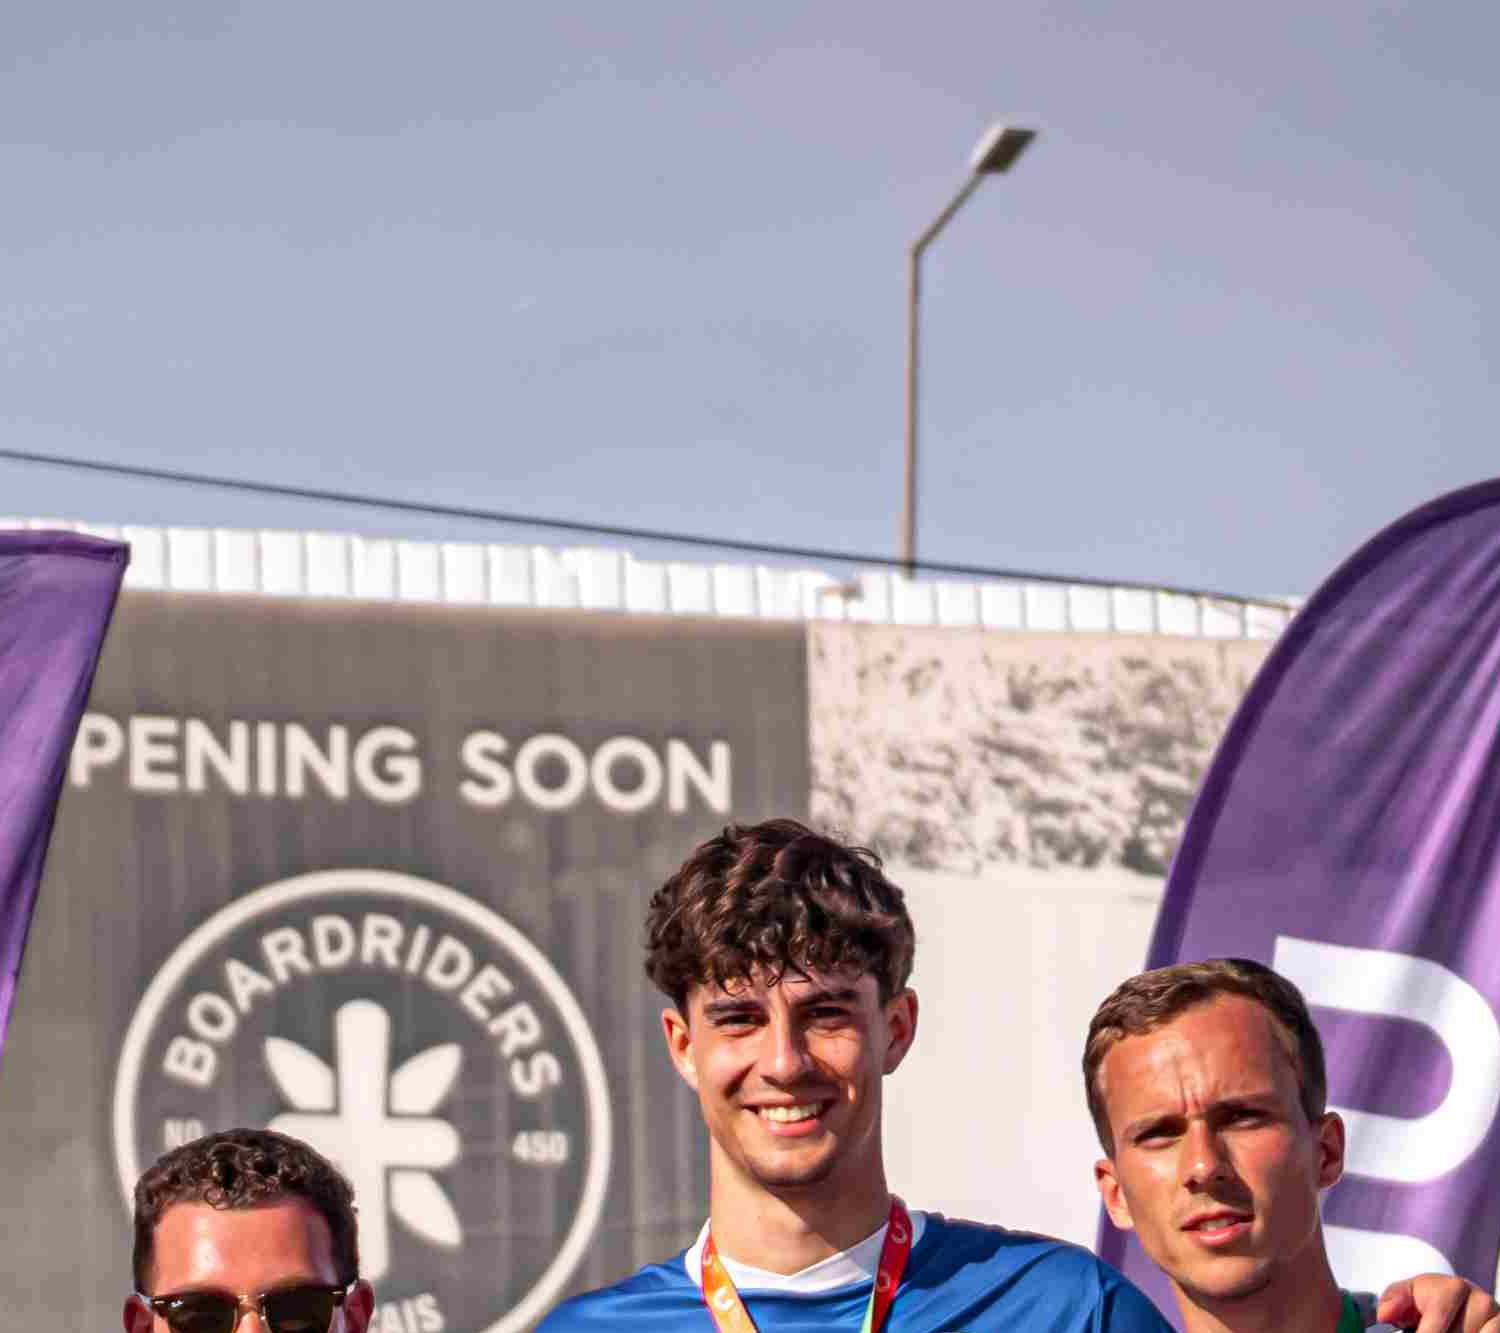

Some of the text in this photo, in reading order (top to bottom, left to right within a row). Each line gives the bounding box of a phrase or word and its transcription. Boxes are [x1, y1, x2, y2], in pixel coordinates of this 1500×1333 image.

[70, 712, 732, 815] PENING SOON
[162, 912, 562, 1097] BOARDRIDERS
